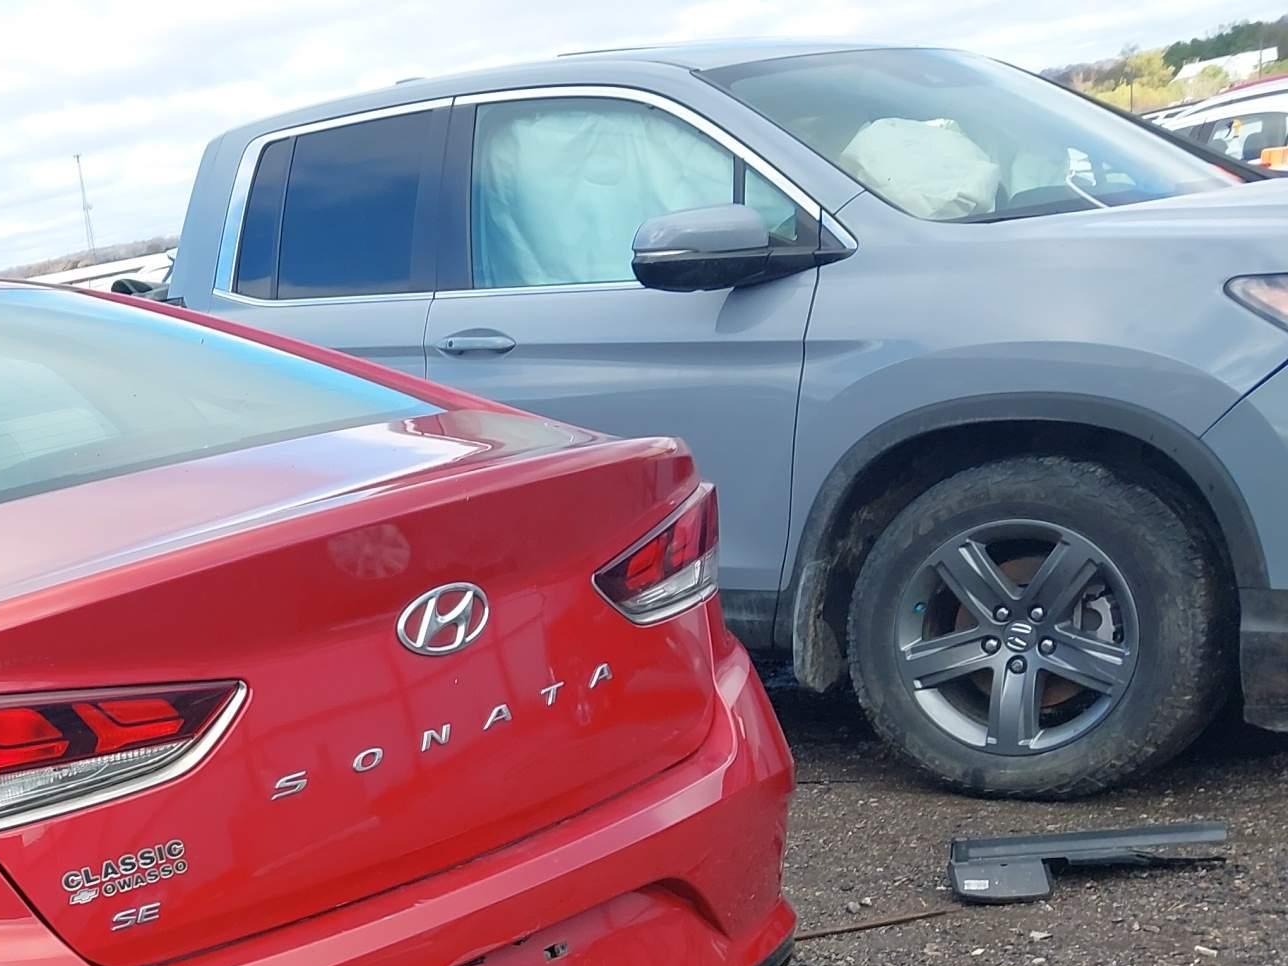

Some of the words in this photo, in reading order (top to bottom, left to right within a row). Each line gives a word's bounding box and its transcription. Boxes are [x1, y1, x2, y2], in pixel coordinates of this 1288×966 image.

[271, 662, 614, 801] SONATA
[62, 839, 186, 892] CLASSIC
[102, 860, 189, 897] OWASSO
[111, 902, 161, 932] SE
